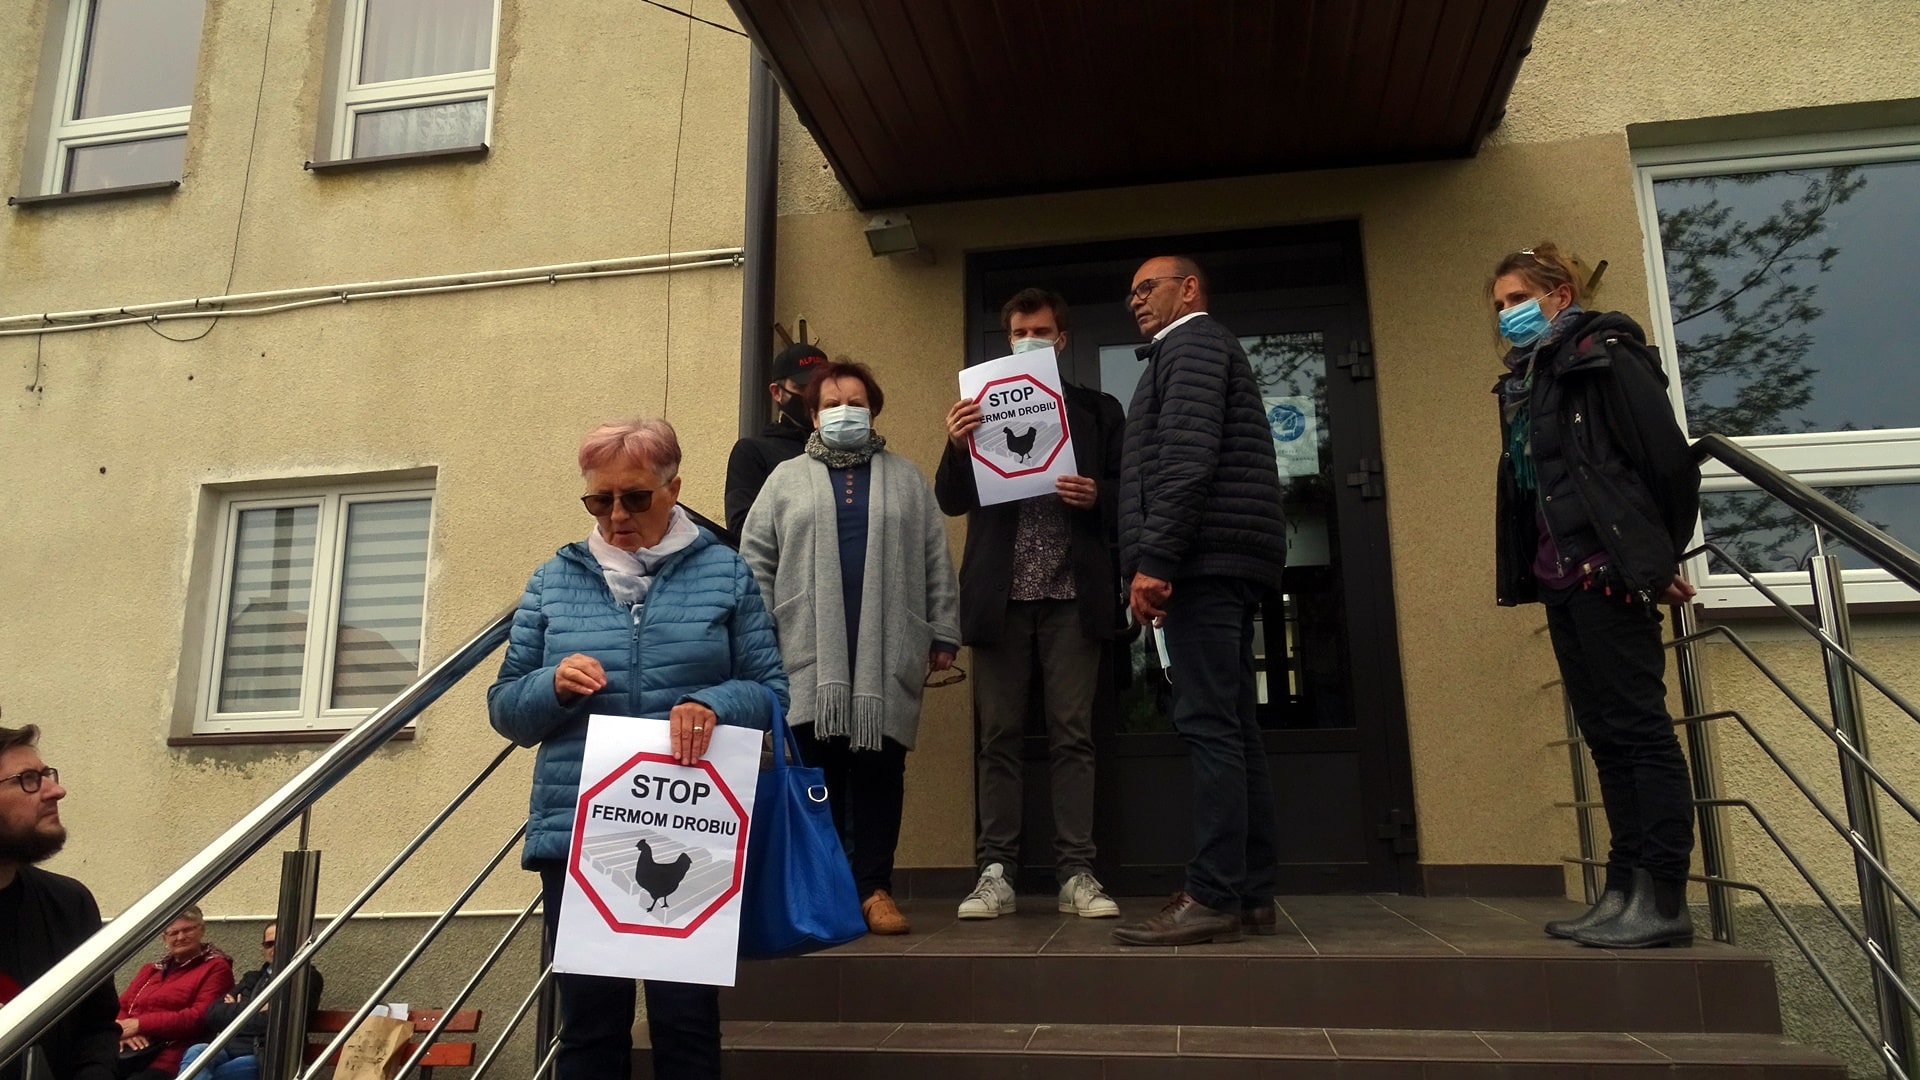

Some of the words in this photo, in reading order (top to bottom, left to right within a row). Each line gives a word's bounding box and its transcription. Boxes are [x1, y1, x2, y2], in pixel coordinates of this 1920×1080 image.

[989, 386, 1034, 407] STOP
[979, 410, 1016, 424] ERMOM
[1018, 402, 1057, 417] DROBIU
[631, 774, 711, 805] STOP
[592, 804, 668, 828] FERMOM
[672, 815, 737, 836] DROBIU
